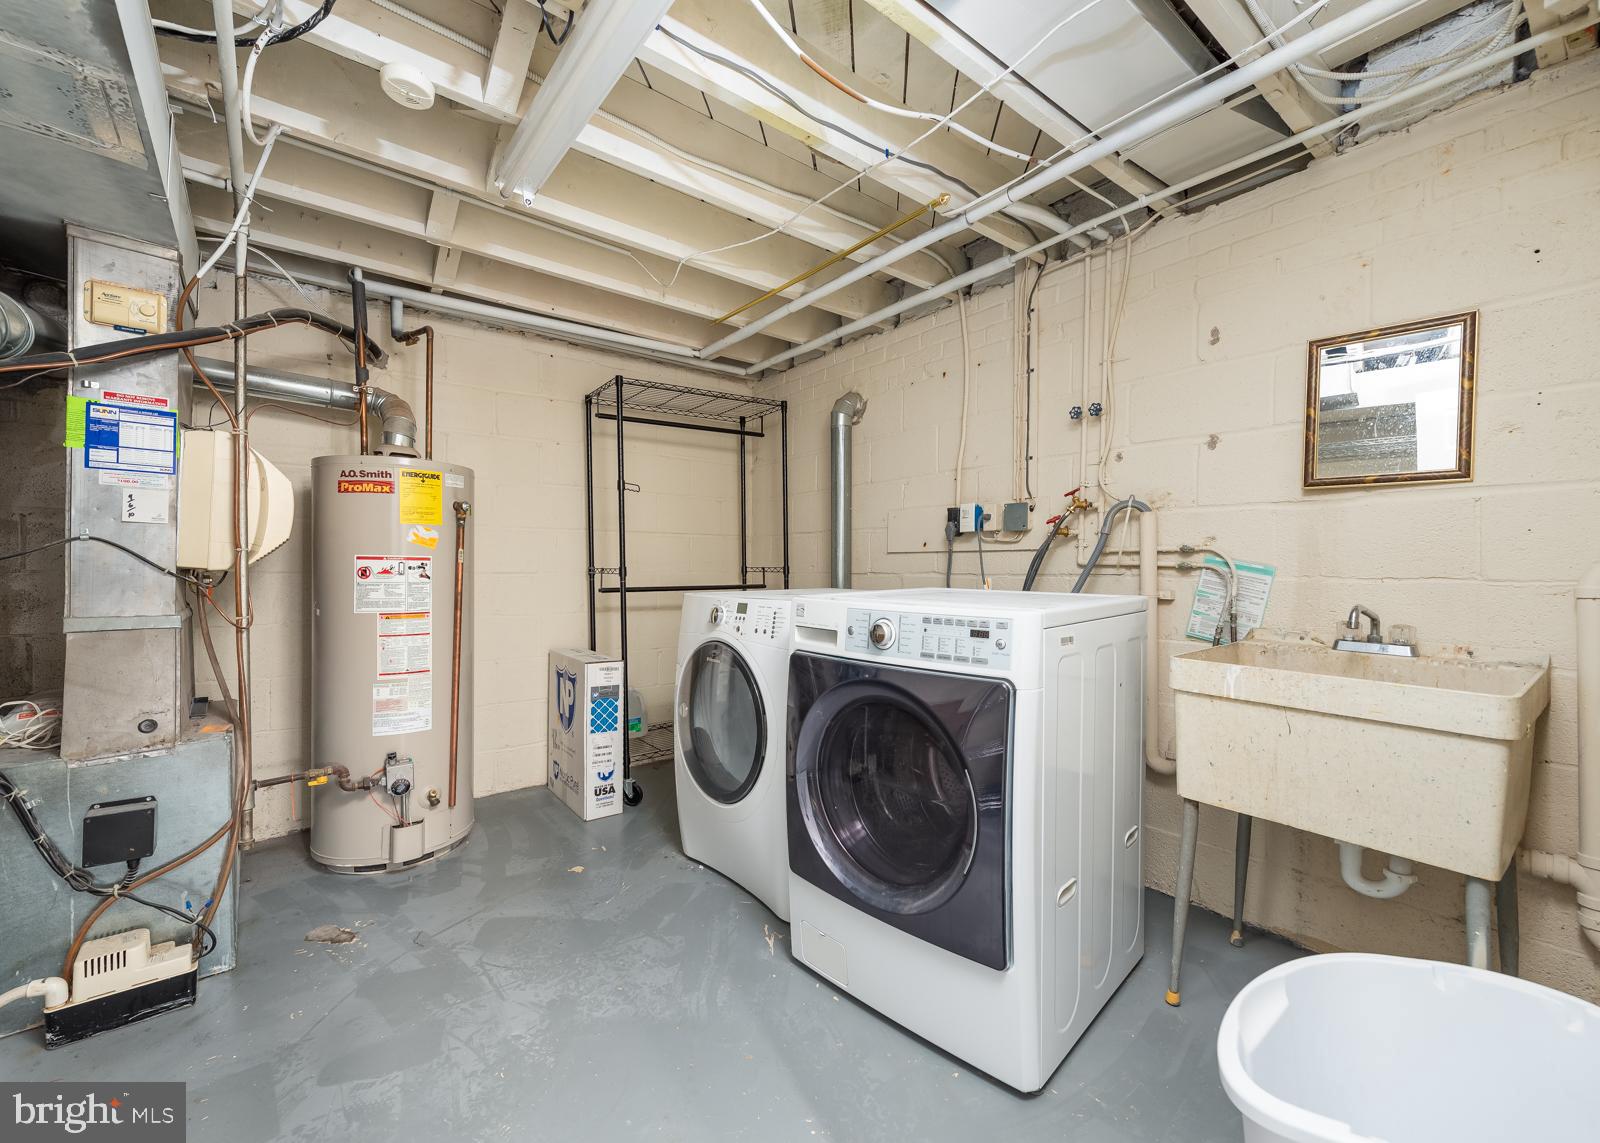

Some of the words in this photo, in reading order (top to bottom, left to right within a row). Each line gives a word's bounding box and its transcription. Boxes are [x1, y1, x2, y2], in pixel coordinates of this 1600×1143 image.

[359, 470, 392, 479] Smith
[340, 482, 391, 493] ProMax
[594, 785, 616, 797] USA
